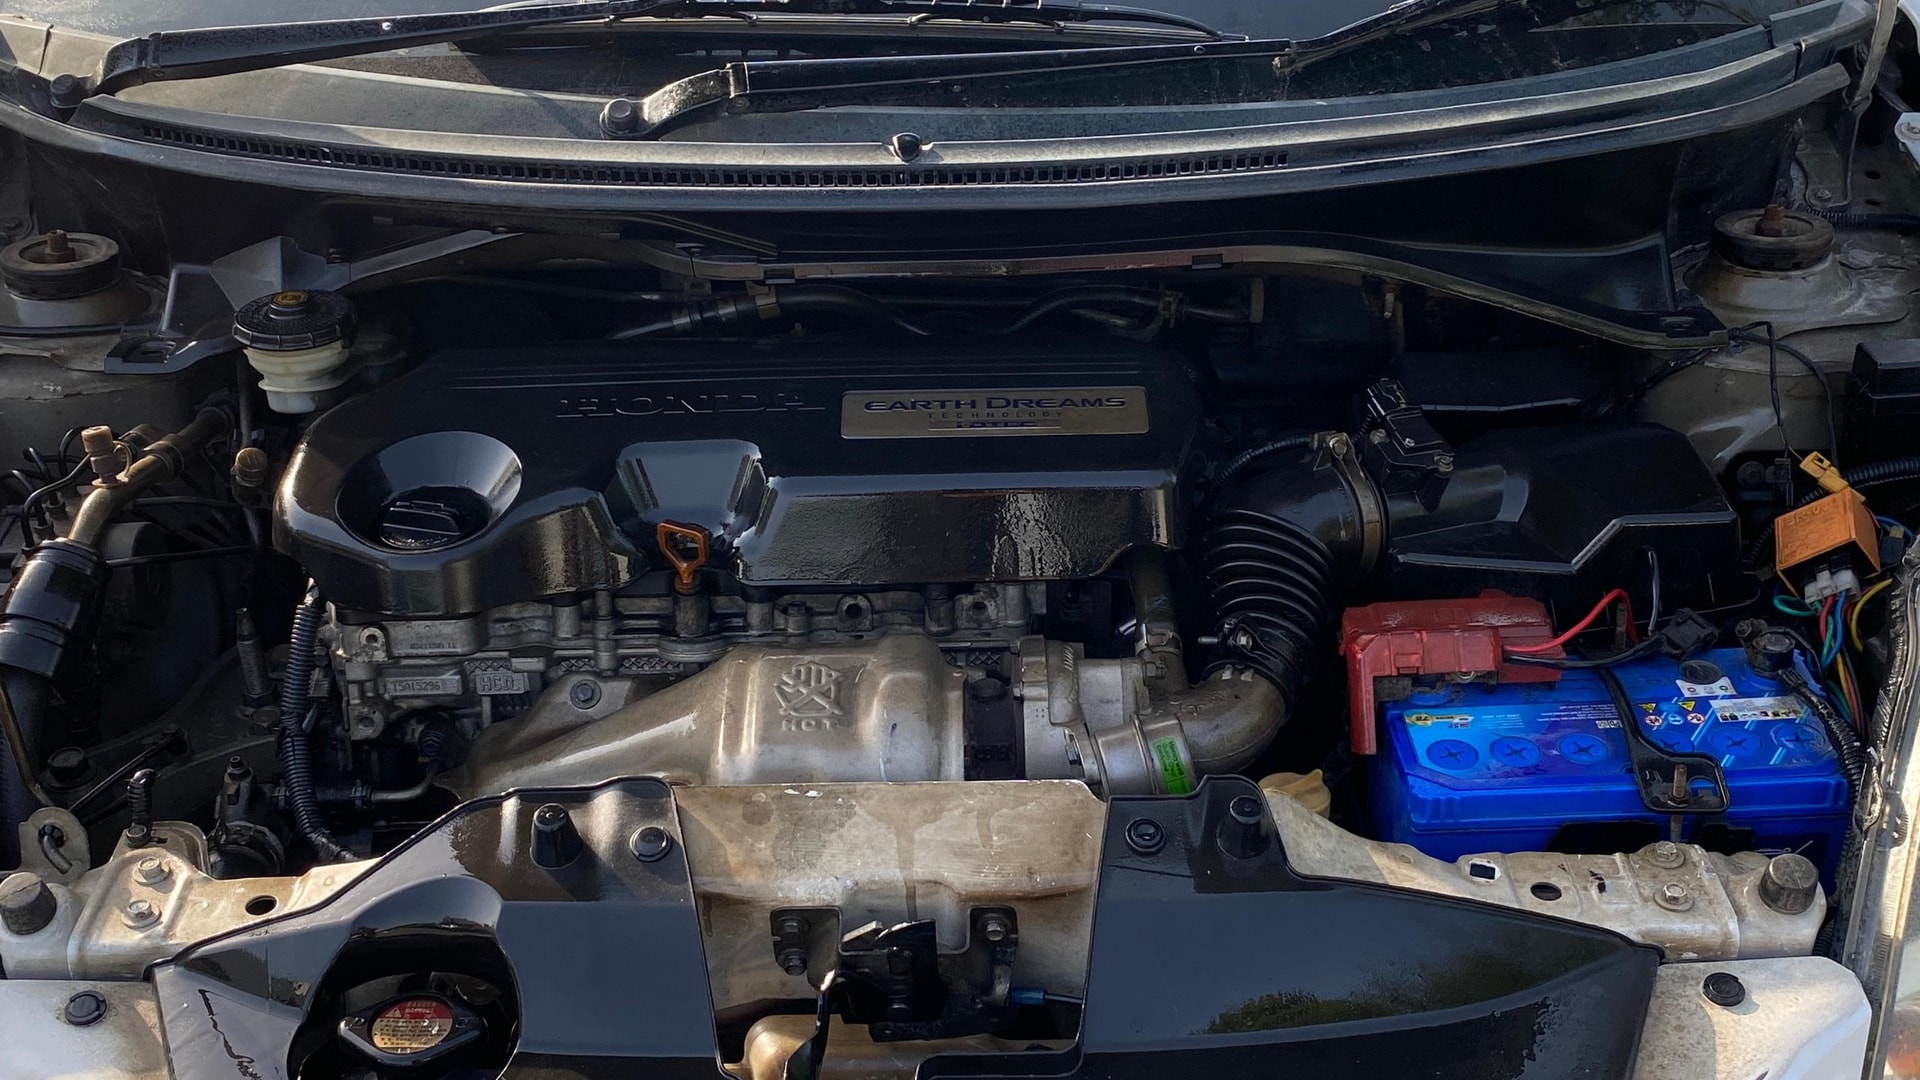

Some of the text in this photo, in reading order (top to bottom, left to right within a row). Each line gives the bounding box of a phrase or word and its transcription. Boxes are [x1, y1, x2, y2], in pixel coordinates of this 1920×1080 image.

[556, 393, 826, 418] HONDA
[864, 397, 1126, 411] EARTH DREAMS
[928, 411, 1064, 419] TECHNOLOGY
[781, 719, 838, 731] HOT
